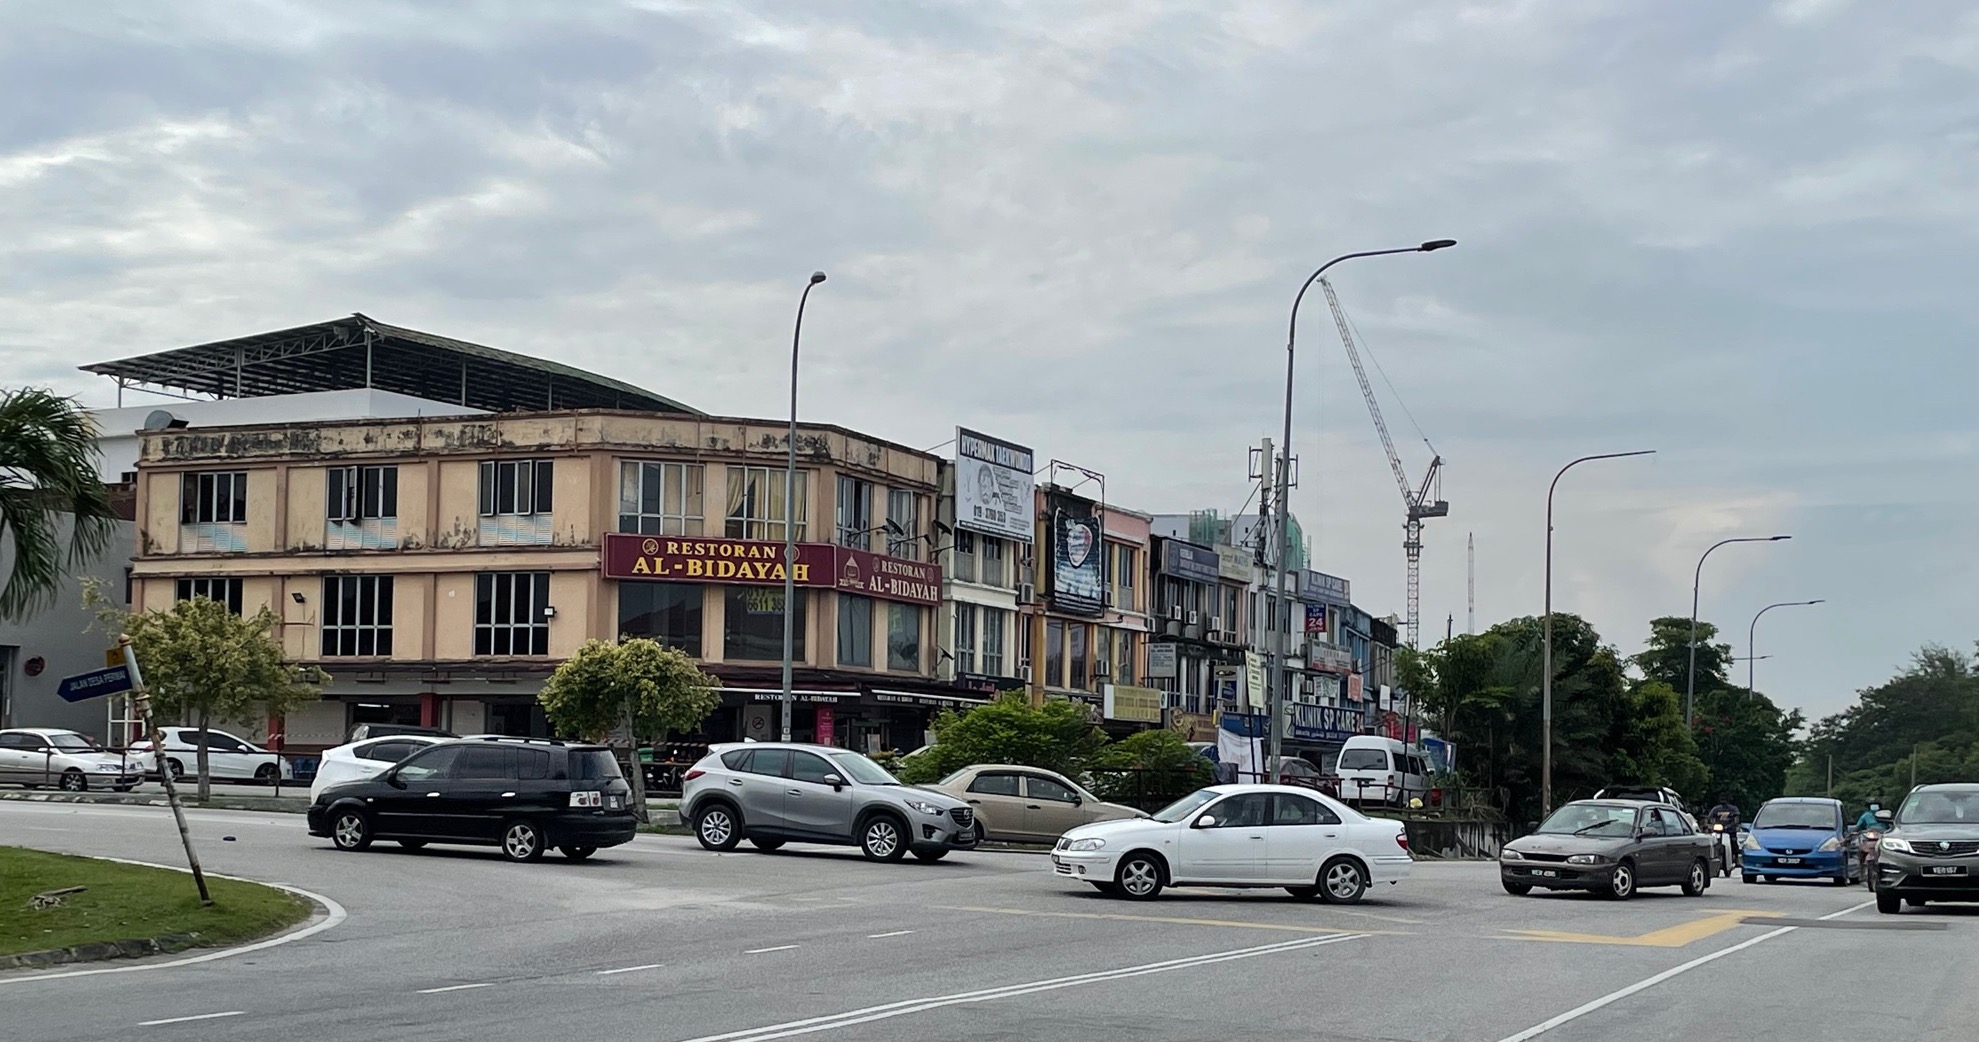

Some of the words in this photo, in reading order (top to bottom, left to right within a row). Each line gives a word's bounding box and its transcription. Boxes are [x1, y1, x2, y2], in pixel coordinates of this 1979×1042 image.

[666, 541, 777, 559] RESTORAN
[631, 556, 811, 581] AL-BIDAYAH
[881, 560, 926, 579] RESTORAN
[868, 575, 938, 602] AL-BIDAYAH
[1308, 617, 1324, 627] 24
[70, 679, 88, 692] JALAN
[754, 693, 798, 701] RESTON
[1294, 704, 1322, 729] KLINIK
[1323, 708, 1334, 731] SP
[1336, 709, 1355, 733] CARE
